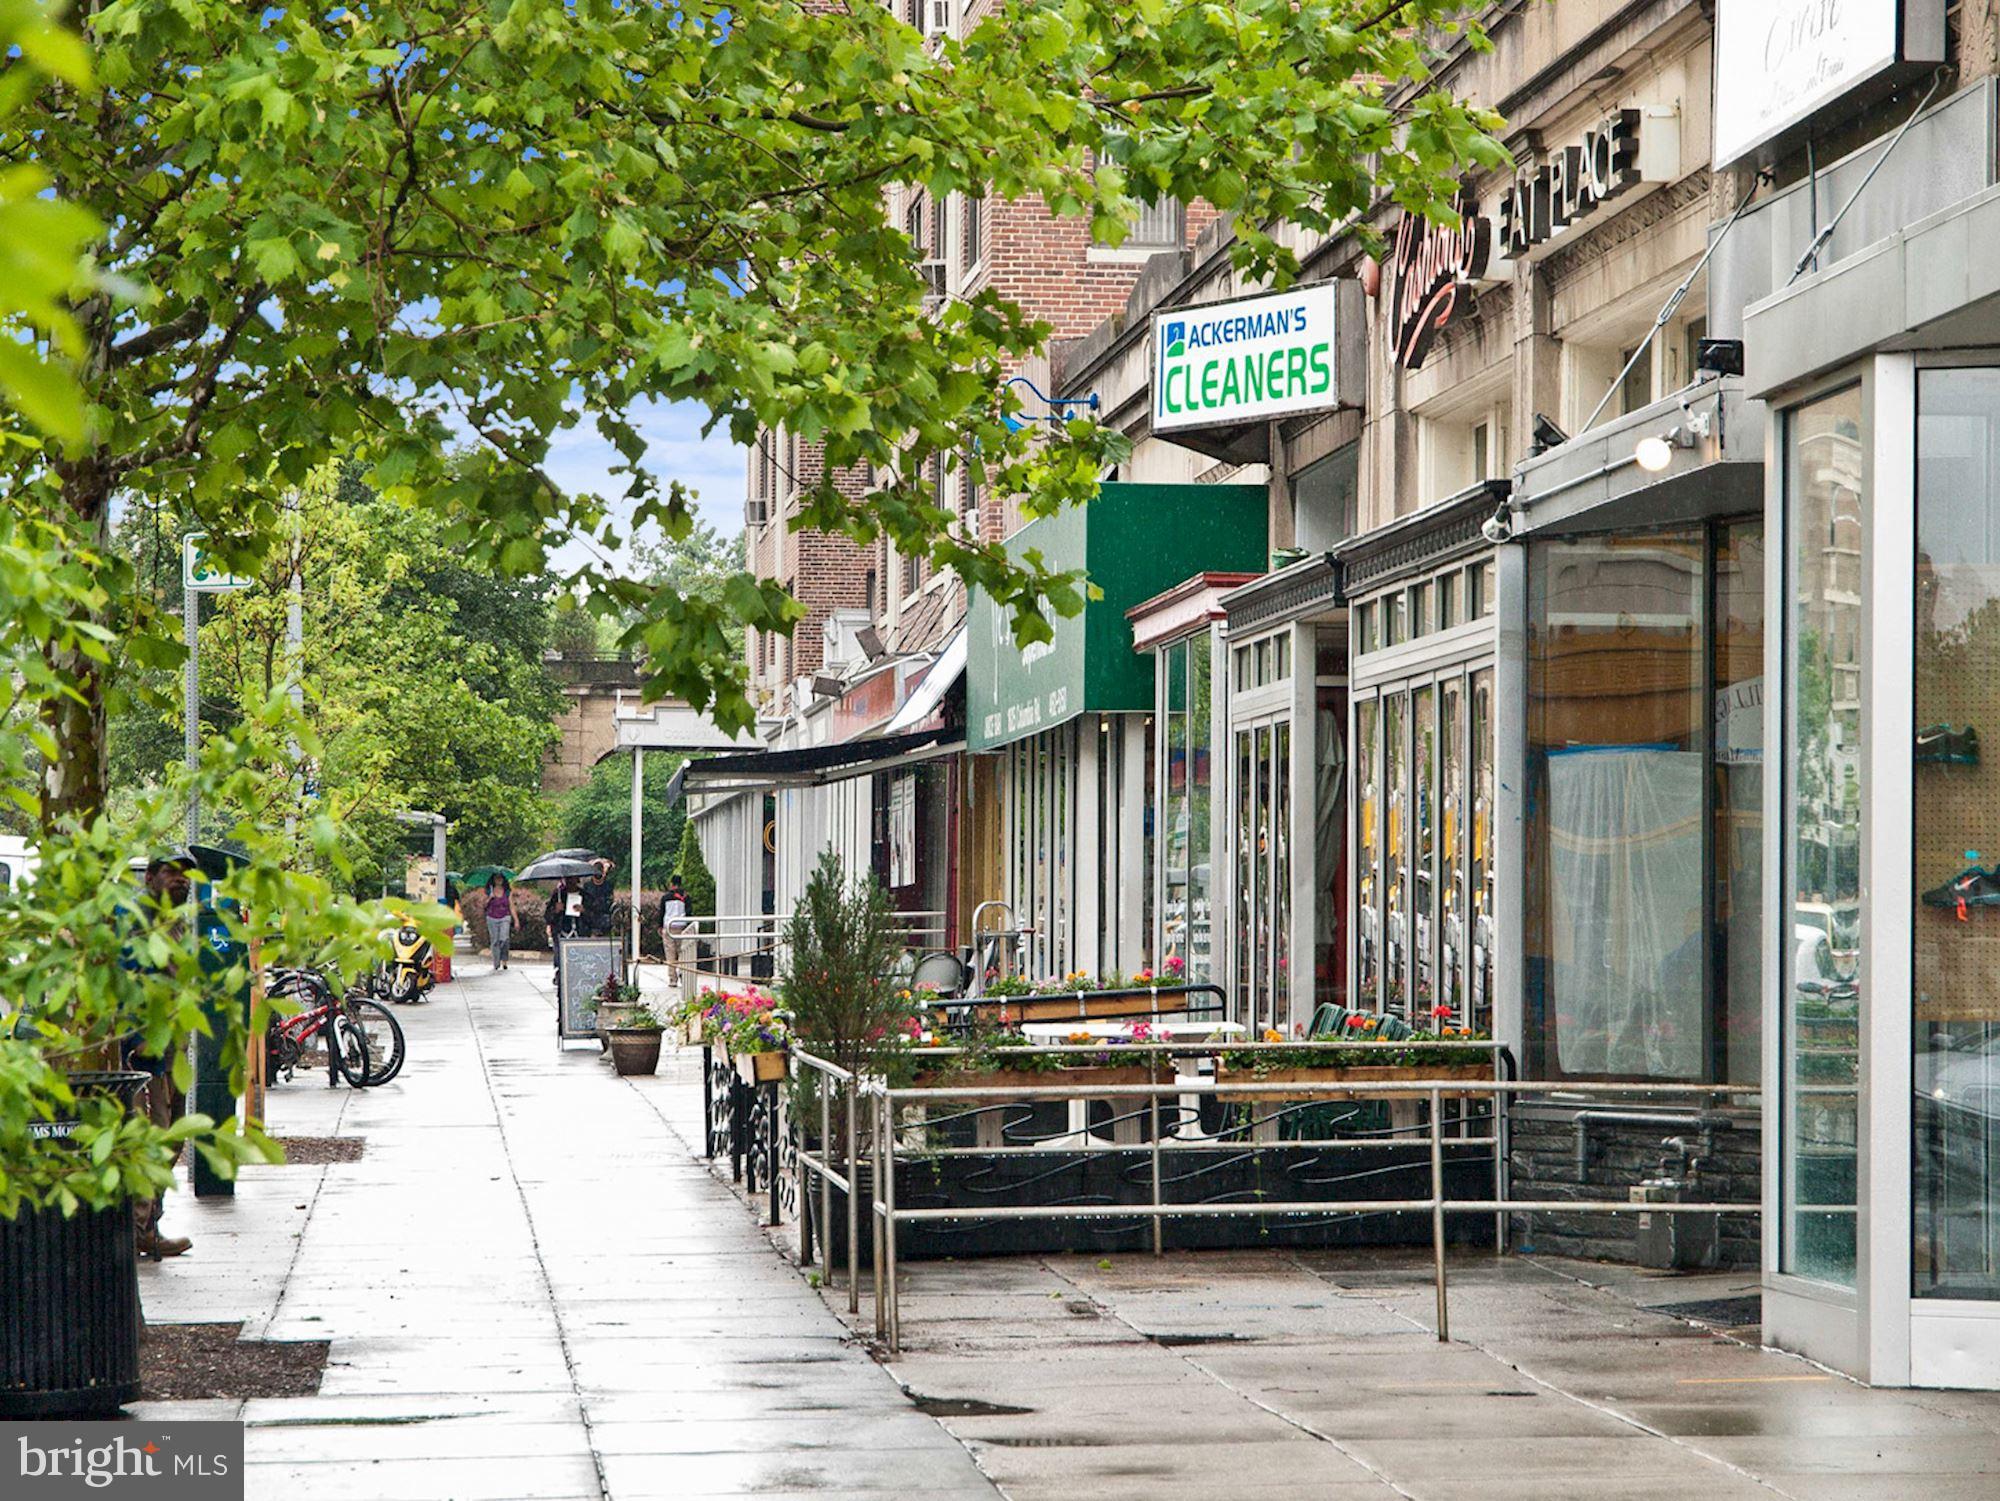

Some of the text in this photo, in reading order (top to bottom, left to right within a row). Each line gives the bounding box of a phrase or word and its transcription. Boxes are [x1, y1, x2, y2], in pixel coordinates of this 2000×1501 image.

[1499, 166, 1550, 259] EAT
[1550, 109, 1641, 226] PLACE
[1188, 306, 1307, 349] ACKERMAN'S
[1165, 342, 1330, 413] CLEANERS
